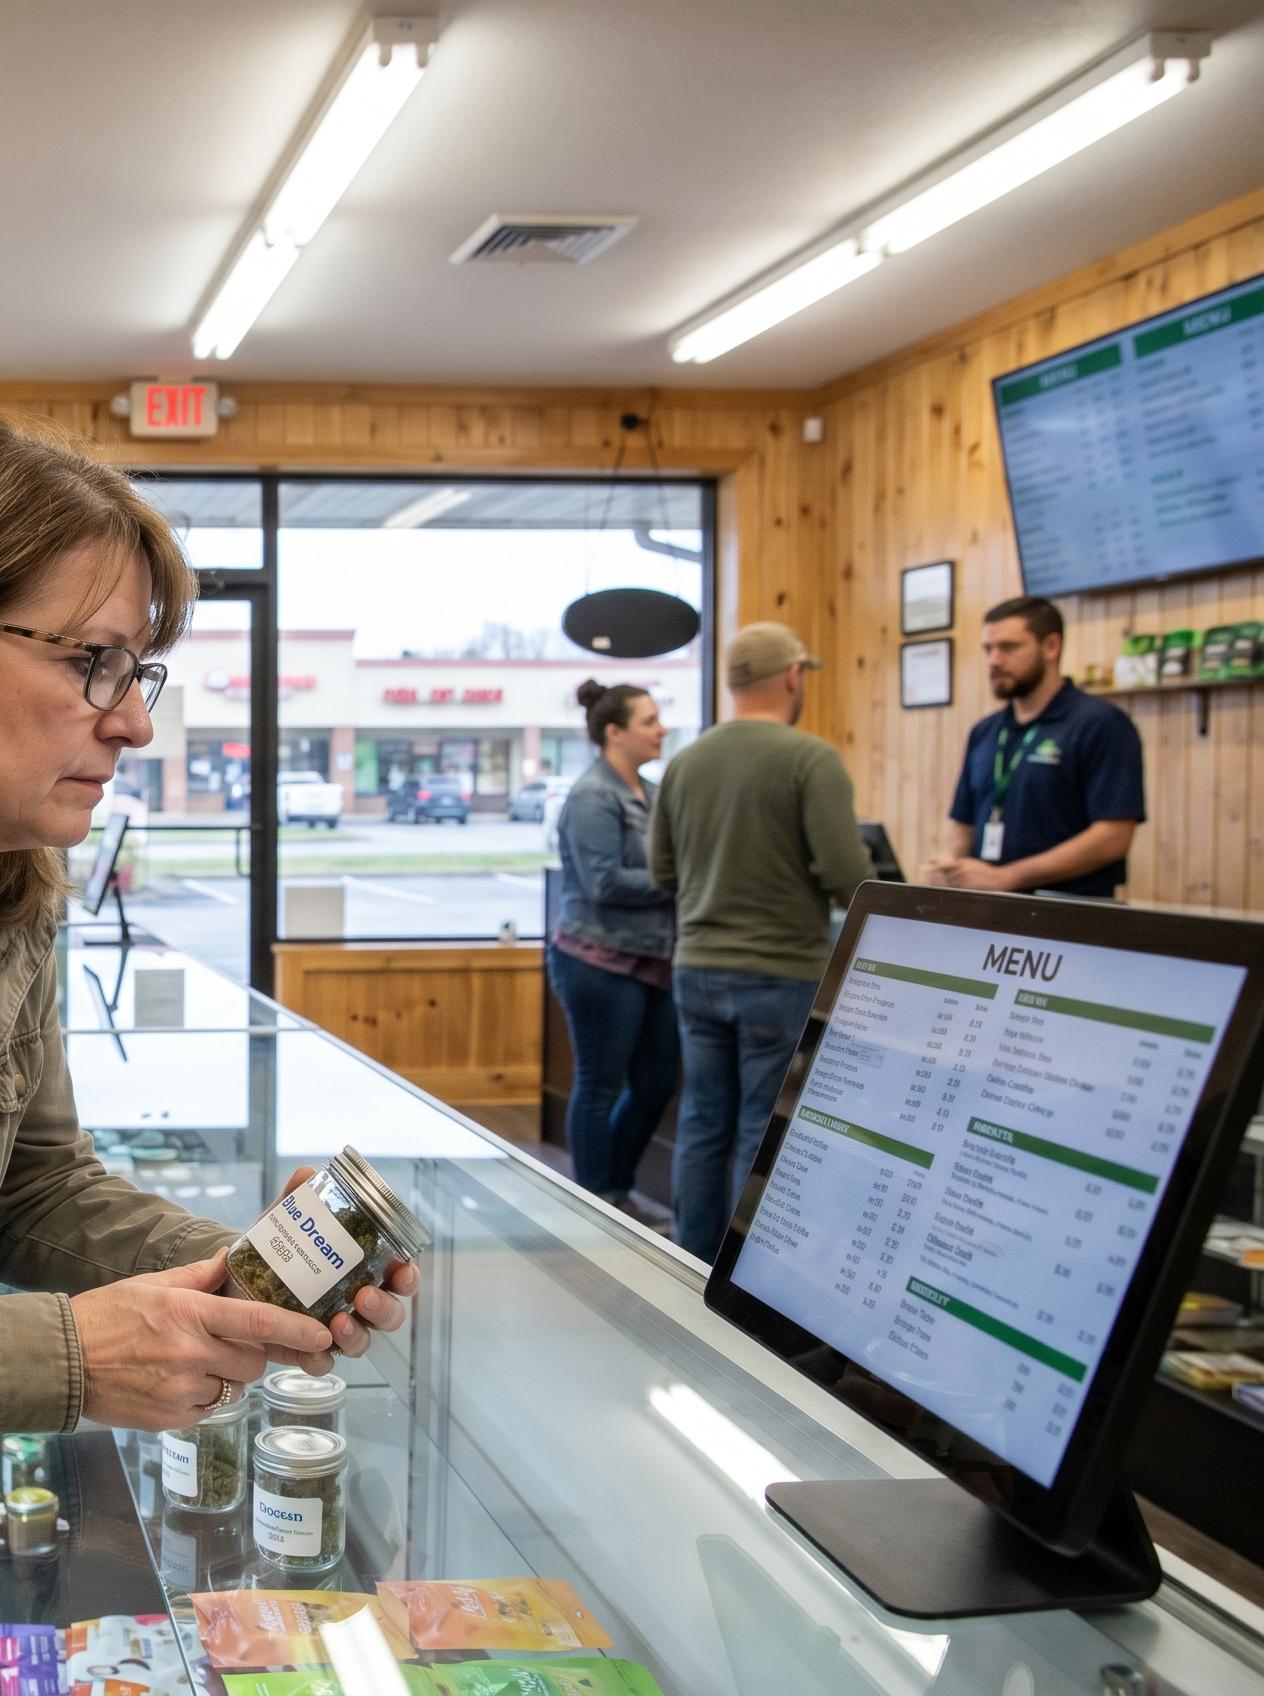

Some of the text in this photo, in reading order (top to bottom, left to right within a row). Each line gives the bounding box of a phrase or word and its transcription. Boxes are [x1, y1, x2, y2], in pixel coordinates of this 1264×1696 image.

[146, 384, 208, 428] EXIT
[981, 943, 1064, 983] MENU
[282, 1194, 302, 1221] Blue
[299, 1216, 345, 1270] Dream
